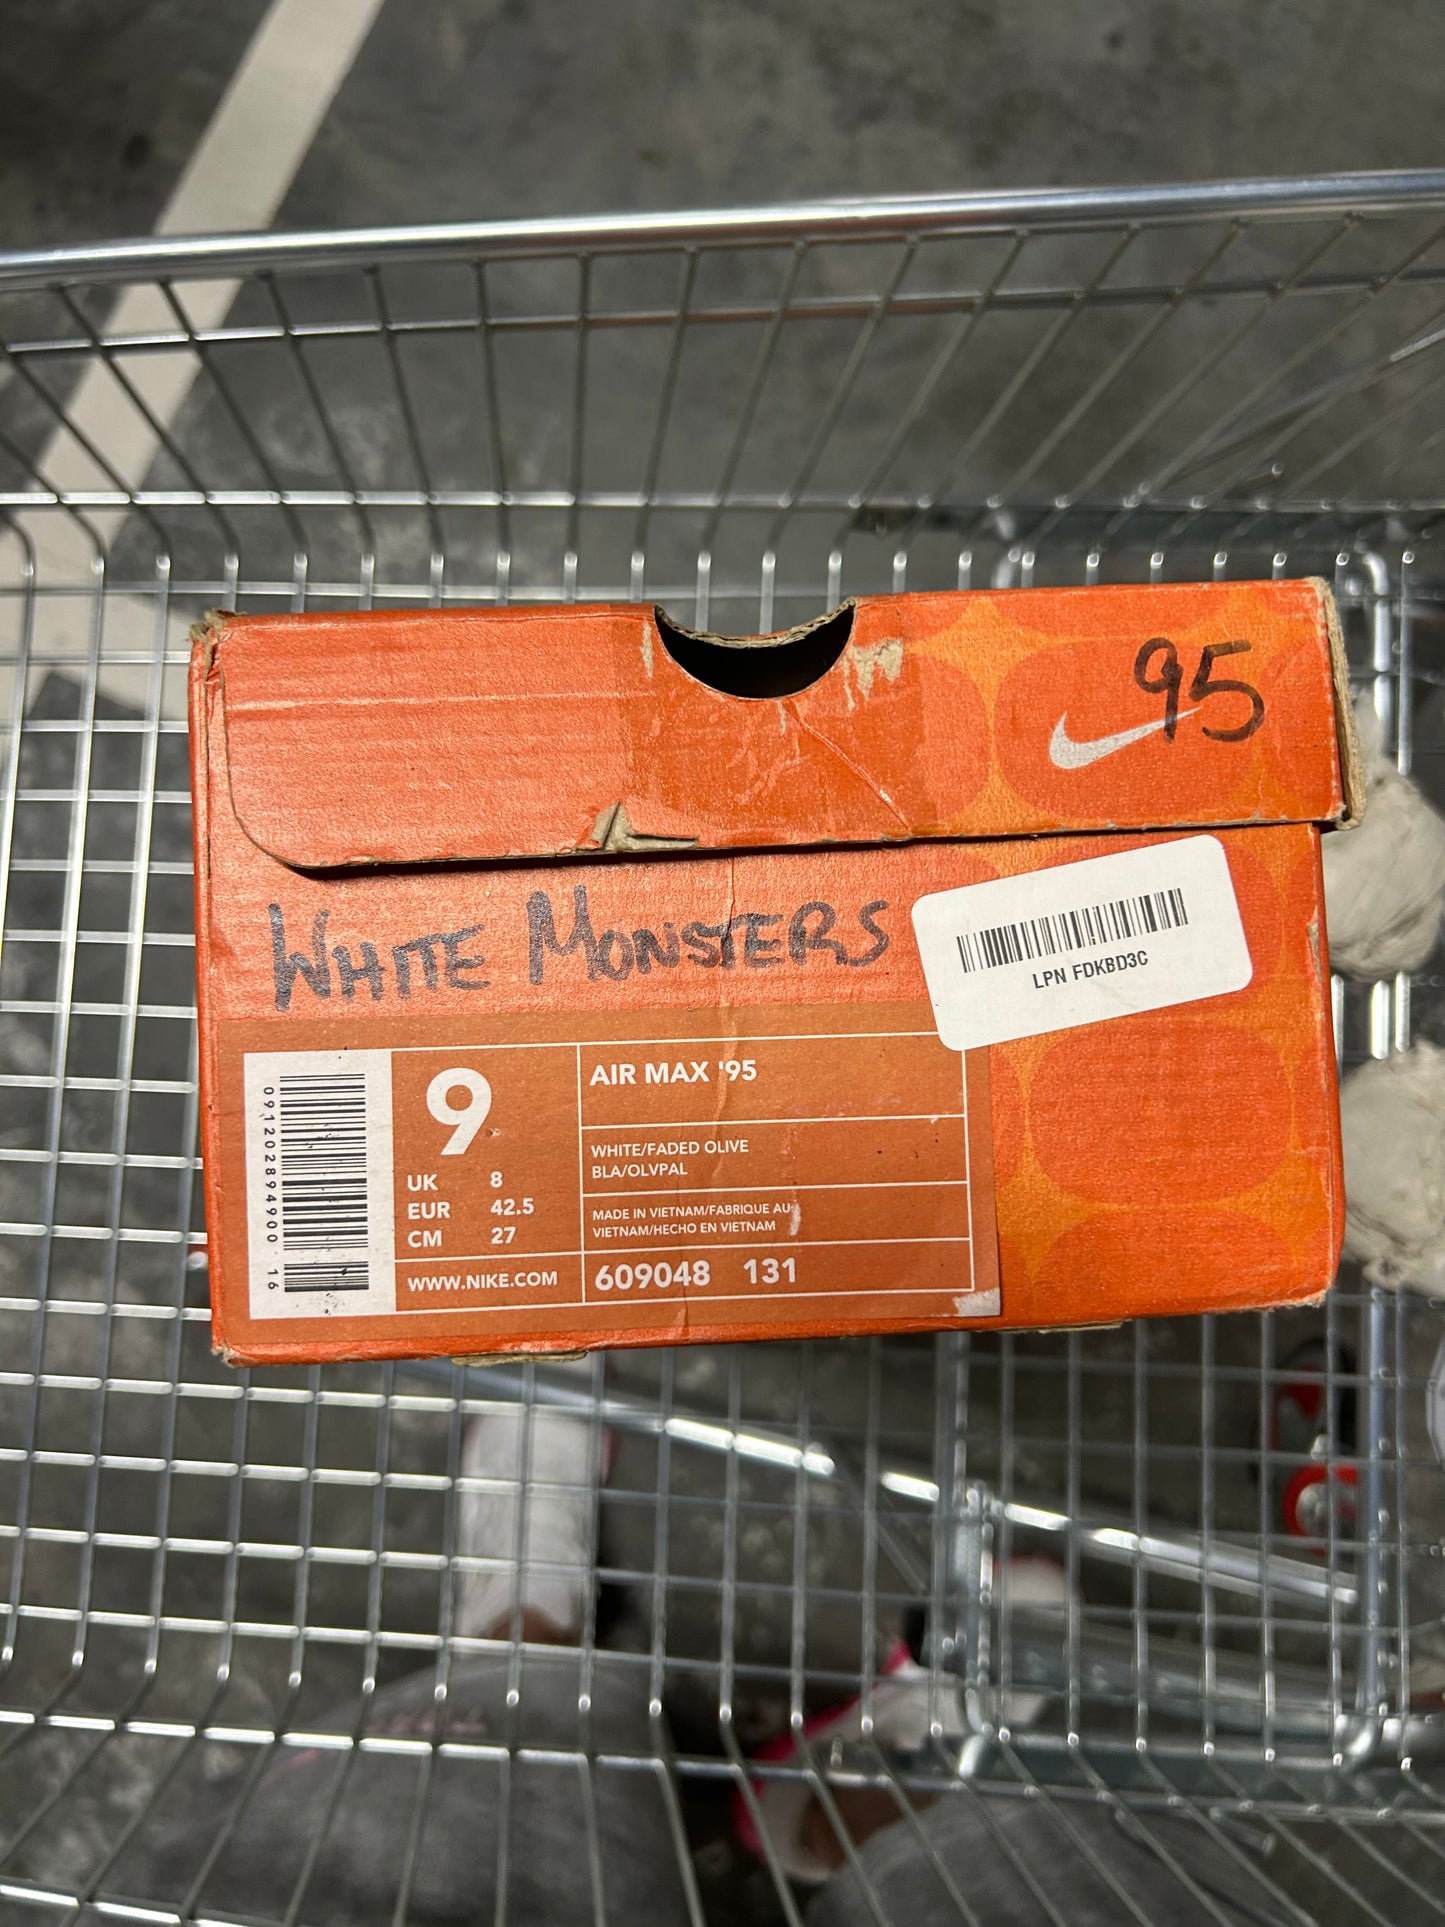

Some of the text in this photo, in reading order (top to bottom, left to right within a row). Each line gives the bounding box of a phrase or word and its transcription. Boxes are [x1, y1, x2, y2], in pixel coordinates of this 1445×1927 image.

[1134, 637, 1265, 742] 95
[1032, 950, 1146, 989] LPN FDKBD3C
[589, 1059, 757, 1086] AIR MAX '95
[426, 1067, 492, 1155] 9
[591, 1139, 749, 1157] WHITE/FADED OLIVE
[592, 1162, 688, 1178] BLA/OLVPAL
[407, 1172, 503, 1191] UK 8
[407, 1198, 535, 1220] EUR 42.5
[592, 1208, 630, 1221] MADE
[634, 1207, 646, 1219] IN
[649, 1203, 769, 1217] VIETNAM/FABRIQUE
[407, 1227, 517, 1248] CM 27
[592, 1219, 776, 1238] VIETNAM/HECHO EN VIETNAM
[407, 1271, 559, 1292] WWW.NIKE.COM
[594, 1257, 796, 1290] 609048 131
